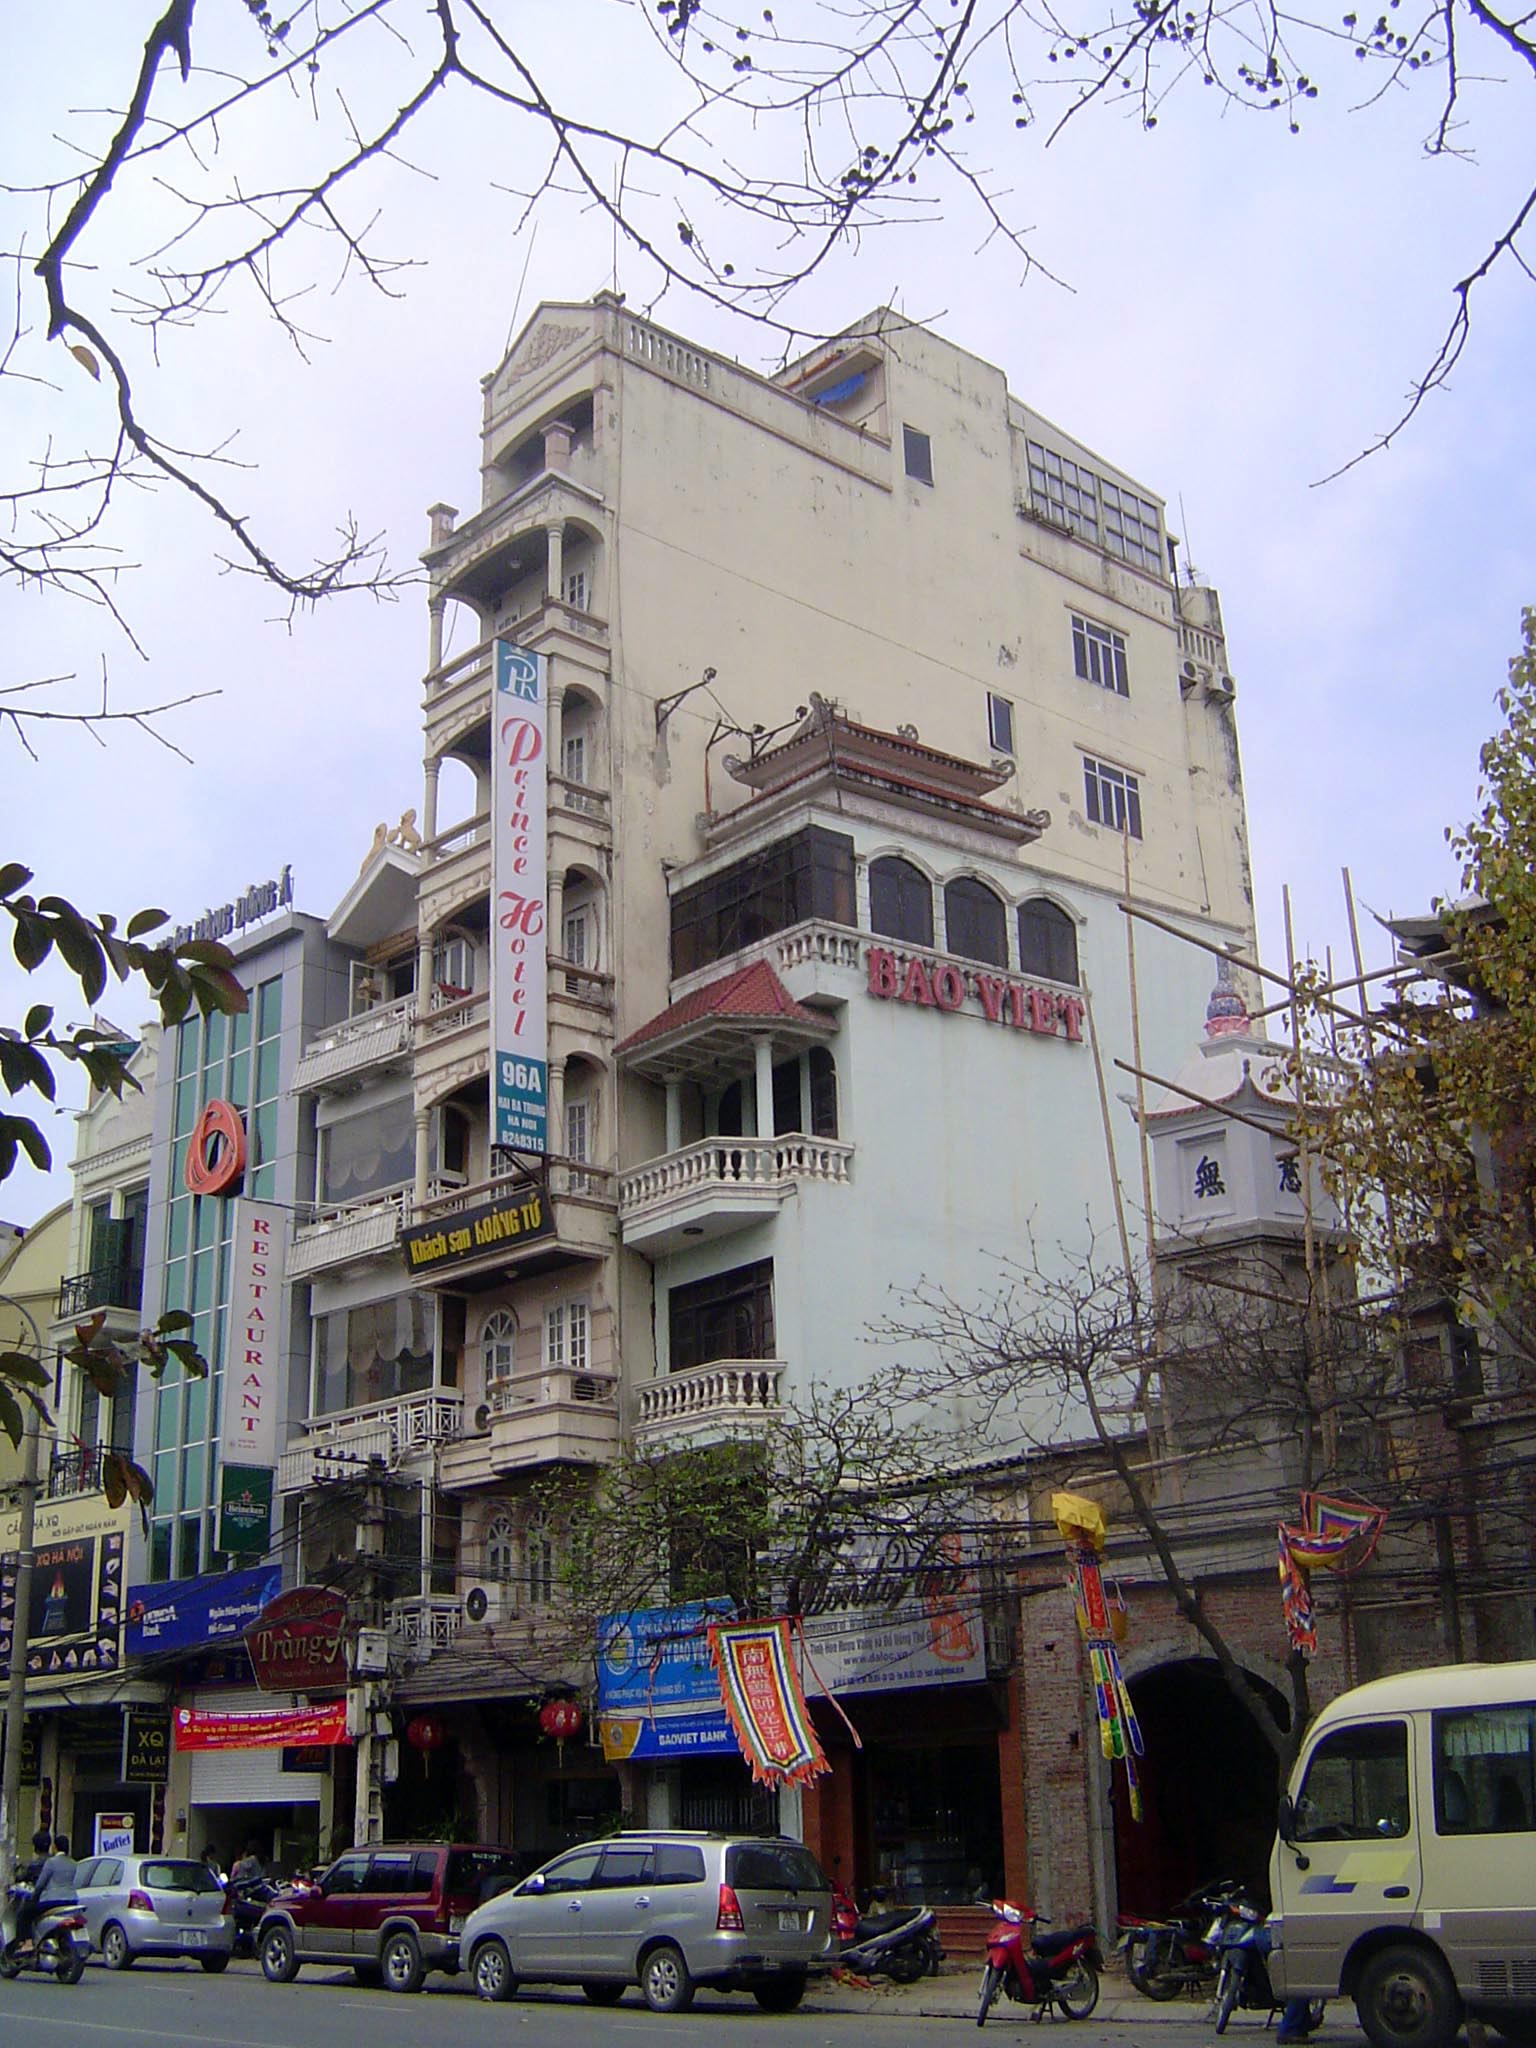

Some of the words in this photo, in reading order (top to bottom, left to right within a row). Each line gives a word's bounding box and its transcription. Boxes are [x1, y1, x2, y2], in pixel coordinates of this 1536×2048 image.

[501, 716, 543, 876] Prince
[499, 890, 544, 1037] Hotel
[865, 943, 964, 1012] BAO
[973, 971, 1086, 1042] VIET
[502, 1060, 542, 1093] 96A
[497, 1095, 510, 1110] HAI
[511, 1097, 522, 1112] BA
[522, 1101, 546, 1118] TRUNG
[507, 1114, 520, 1127] HA
[521, 1117, 537, 1131] NOI
[502, 1129, 544, 1152] 8248315
[409, 1231, 448, 1265] Khách
[448, 1227, 472, 1256] sạn
[520, 1192, 542, 1231] TỬ
[241, 1218, 270, 1432] RESTAURANT
[46, 1514, 60, 1527] XQ
[36, 1553, 50, 1569] XQ
[66, 1546, 84, 1563] NỘI
[257, 1629, 324, 1665] Tràng
[138, 1730, 165, 1748] XQ
[658, 1732, 698, 1746] BAOVIET
[700, 1729, 728, 1743] BANK
[148, 1754, 167, 1768] LẠT
[103, 1833, 131, 1853] Buffet
